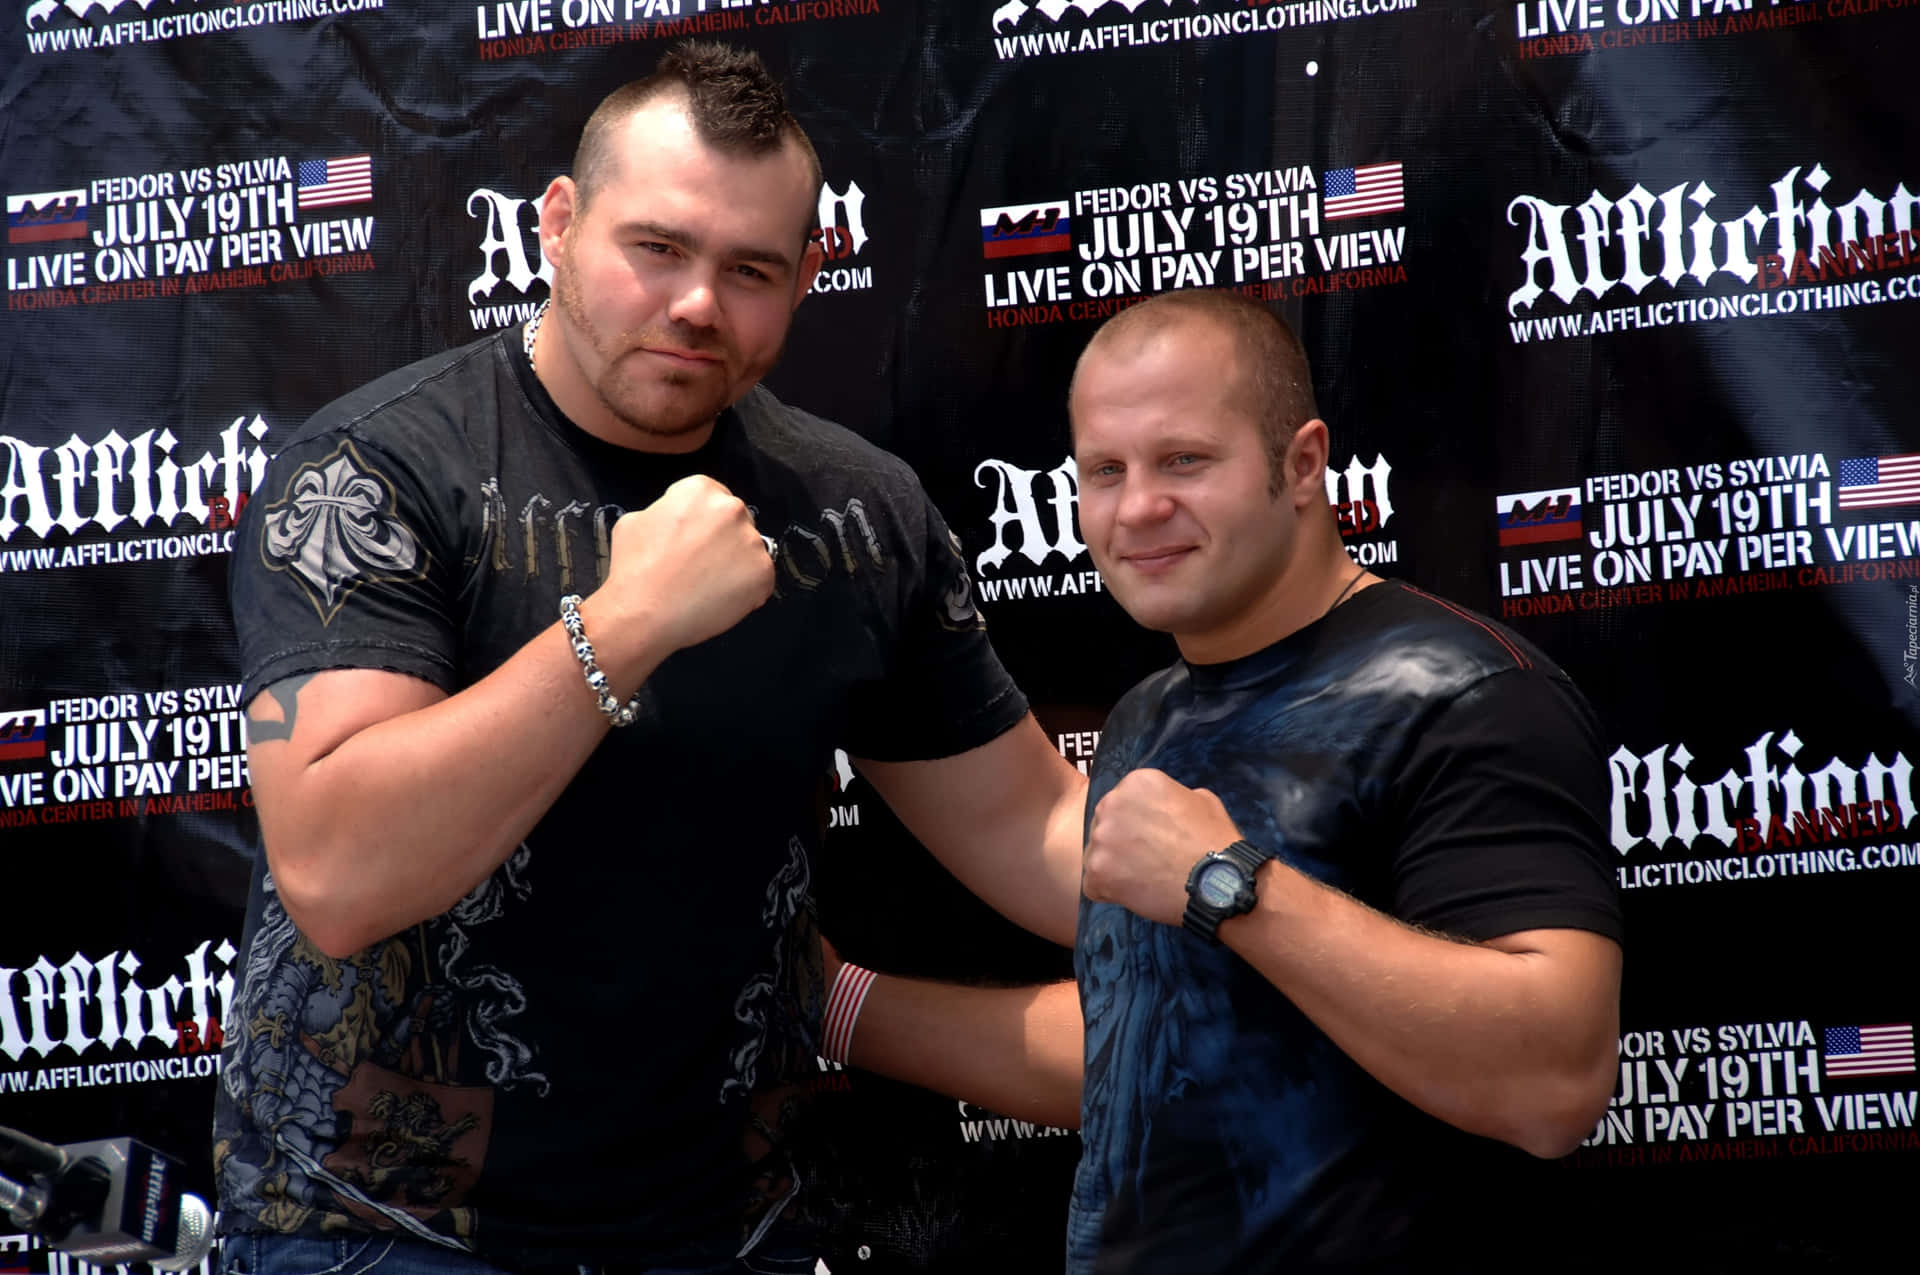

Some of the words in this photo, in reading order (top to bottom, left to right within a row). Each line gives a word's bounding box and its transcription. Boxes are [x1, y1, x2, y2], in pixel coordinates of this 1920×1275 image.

[477, 0, 553, 39] LIVE
[561, 0, 615, 28] ON
[480, 34, 546, 61] HONDA
[549, 24, 625, 51] CENTER
[629, 20, 650, 42] IN
[755, 0, 880, 25] CALIFORNIA
[1517, 0, 1604, 38] LIVE
[1519, 32, 1594, 60] HONDA
[1600, 22, 1690, 49] CENTER
[1697, 17, 1718, 40] IN
[92, 172, 175, 204] FEDOR
[180, 167, 212, 194] VS
[216, 156, 293, 189] SYLVIA
[1075, 182, 1172, 216] FEDOR
[1178, 176, 1218, 204] VS
[1225, 165, 1317, 200] SYLVIA
[93, 196, 195, 248] JULY
[201, 182, 295, 234] 19TH
[1078, 207, 1195, 261] JULY
[1204, 192, 1319, 247] 19TH
[7, 252, 87, 291] LIVE
[94, 245, 146, 283] ON
[156, 237, 214, 276] PAY
[221, 228, 283, 269] PER
[289, 216, 374, 258] VIEW
[984, 266, 1072, 308] LIVE
[1082, 259, 1141, 298] ON
[1152, 250, 1222, 291] PAY
[1233, 242, 1306, 283] PER
[1314, 226, 1406, 272] VIEW
[8, 288, 78, 311] HONDA
[82, 280, 156, 304] CENTER
[161, 277, 180, 296] IN
[270, 253, 376, 283] CALIFORNIA
[987, 304, 1064, 329] HONDA
[1292, 265, 1408, 297] CALIFORNIA
[1586, 468, 1681, 503] FEDOR
[1685, 463, 1724, 491] VS
[1729, 453, 1831, 487] SYLVIA
[1589, 494, 1703, 549] JULY
[1711, 481, 1832, 535] 19TH
[1500, 554, 1584, 597] LIVE
[1592, 547, 1652, 587] ON
[1662, 538, 1729, 580] PAY
[1737, 530, 1815, 572] PER
[1824, 520, 1920, 562] VIEW
[1502, 593, 1575, 618] HONDA
[1579, 584, 1663, 610] CENTER
[1669, 580, 1689, 601] IN
[50, 694, 138, 724] FEDOR
[144, 690, 179, 716] VS
[50, 718, 160, 768] JULY
[53, 766, 105, 803] ON
[115, 760, 181, 798] PAY
[188, 754, 252, 792] PER
[41, 802, 115, 825] CENTER
[119, 800, 139, 818] IN
[1735, 799, 1901, 853] BANNED
[1671, 1027, 1712, 1054] VS
[1718, 1020, 1817, 1052] SYLVIA
[1698, 1049, 1820, 1100] 19TH
[1644, 1103, 1716, 1143] PAY
[1726, 1098, 1805, 1138] PER
[1814, 1091, 1918, 1132] VIEW
